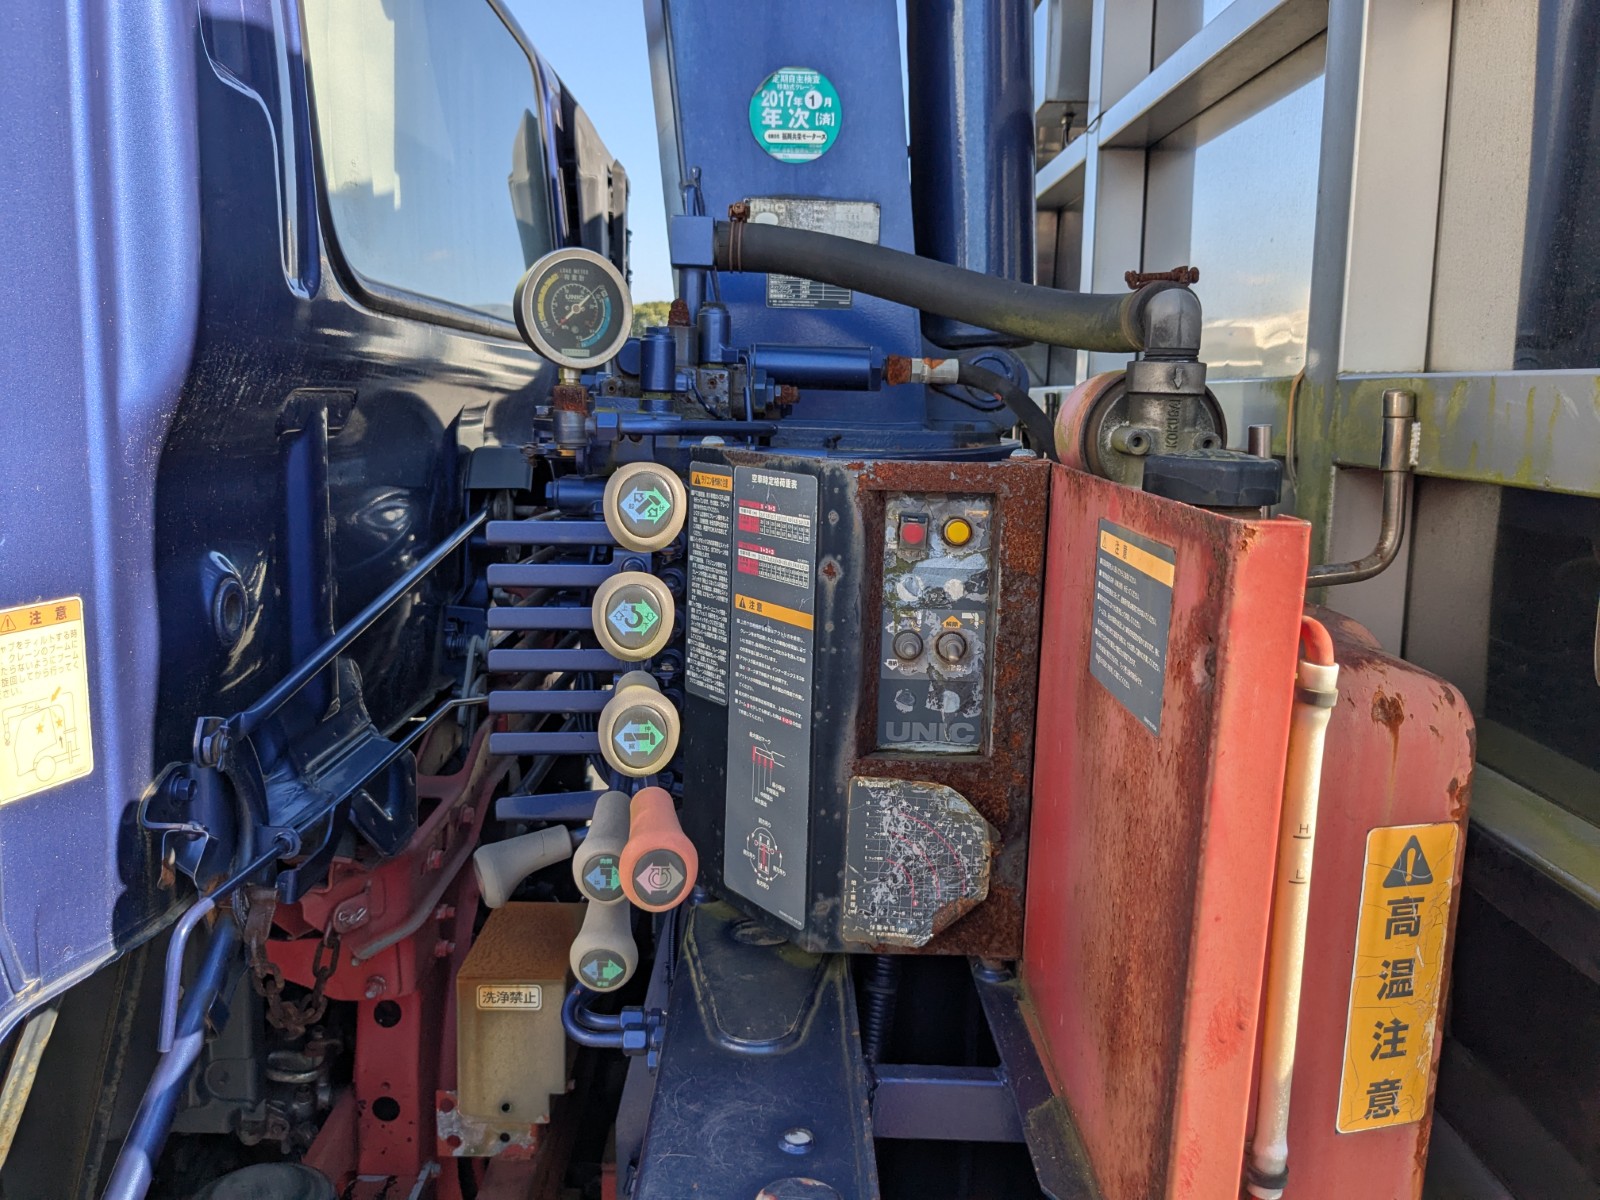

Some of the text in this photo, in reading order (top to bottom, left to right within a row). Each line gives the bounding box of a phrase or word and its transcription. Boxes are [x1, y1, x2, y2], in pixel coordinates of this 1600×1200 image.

[748, 601, 763, 613] 注意
[29, 605, 68, 625] 注意
[885, 721, 976, 744] UNIC
[1298, 823, 1309, 835] H
[1295, 868, 1305, 880] L
[482, 991, 537, 1004] 洗浄禁止
[1363, 895, 1426, 1122] 高温注意
